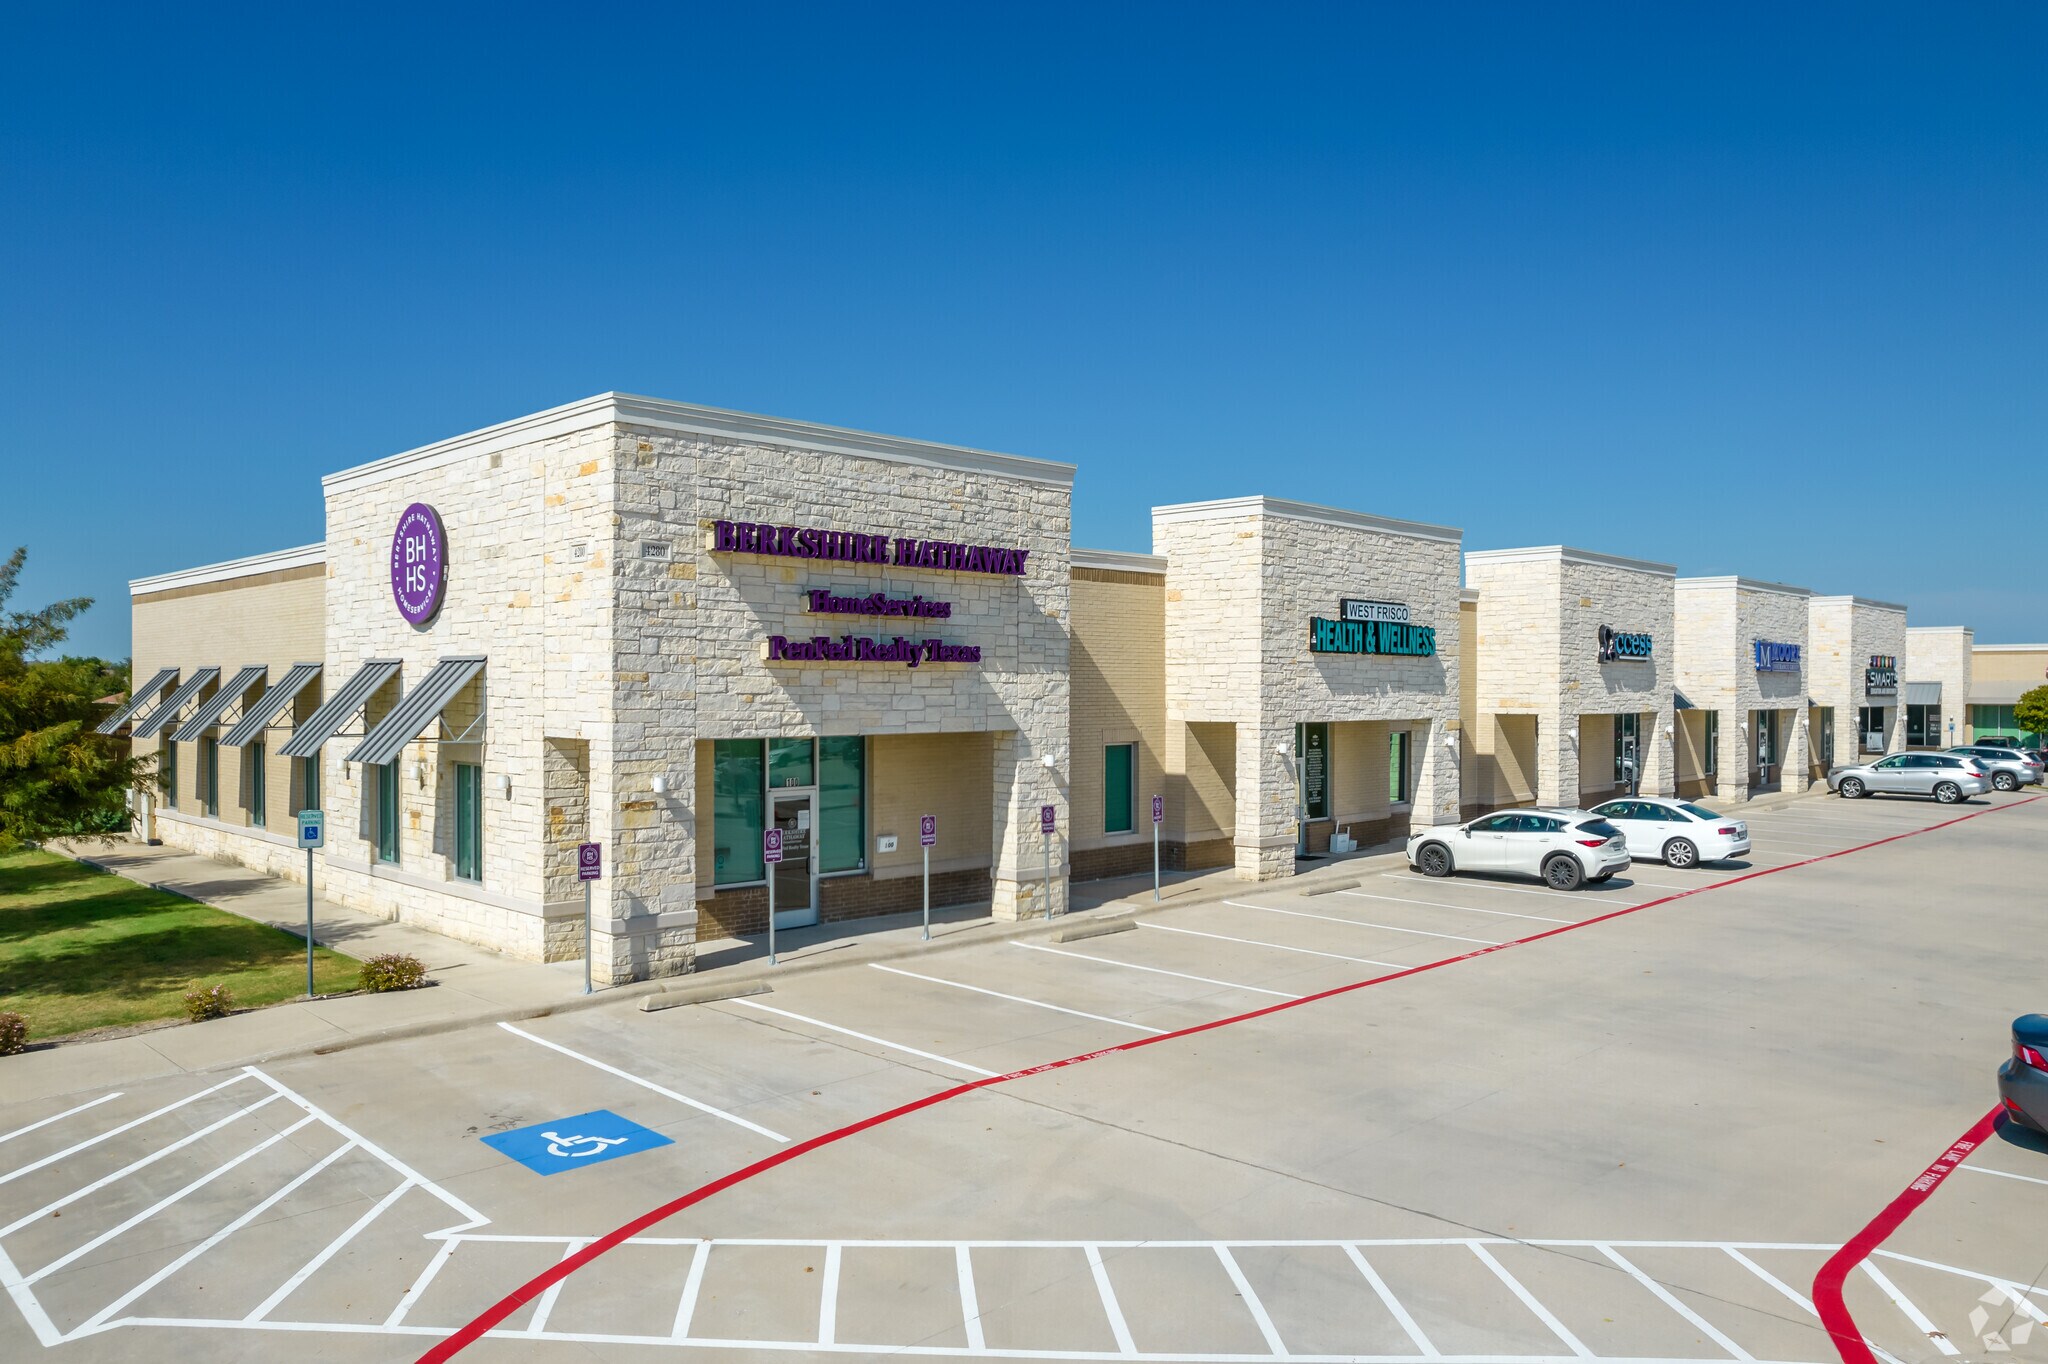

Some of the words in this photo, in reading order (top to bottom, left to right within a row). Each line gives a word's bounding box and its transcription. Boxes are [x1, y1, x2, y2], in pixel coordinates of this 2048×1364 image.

[394, 513, 415, 568] BERKSHIRE
[416, 513, 437, 562] HATHAWAY
[406, 535, 426, 563] BH
[645, 545, 666, 556] 4280
[713, 520, 889, 564] BERKSHIRE
[893, 538, 1029, 575] HATHAWAY
[406, 565, 426, 593] HS
[809, 589, 951, 618] HomeServices
[1349, 603, 1374, 618] WEST
[1377, 606, 1408, 620] FRISCO
[1316, 617, 1363, 652] HEALTH
[1366, 621, 1376, 654] &
[1378, 622, 1436, 656] WELLNESS
[767, 635, 854, 661] PenFed
[856, 636, 926, 667] Realty
[925, 639, 981, 662] Texas
[1942, 1150, 1965, 1162] LANE
[1954, 1140, 1975, 1151] FIRE
[1910, 1171, 1941, 1191] PARKING
